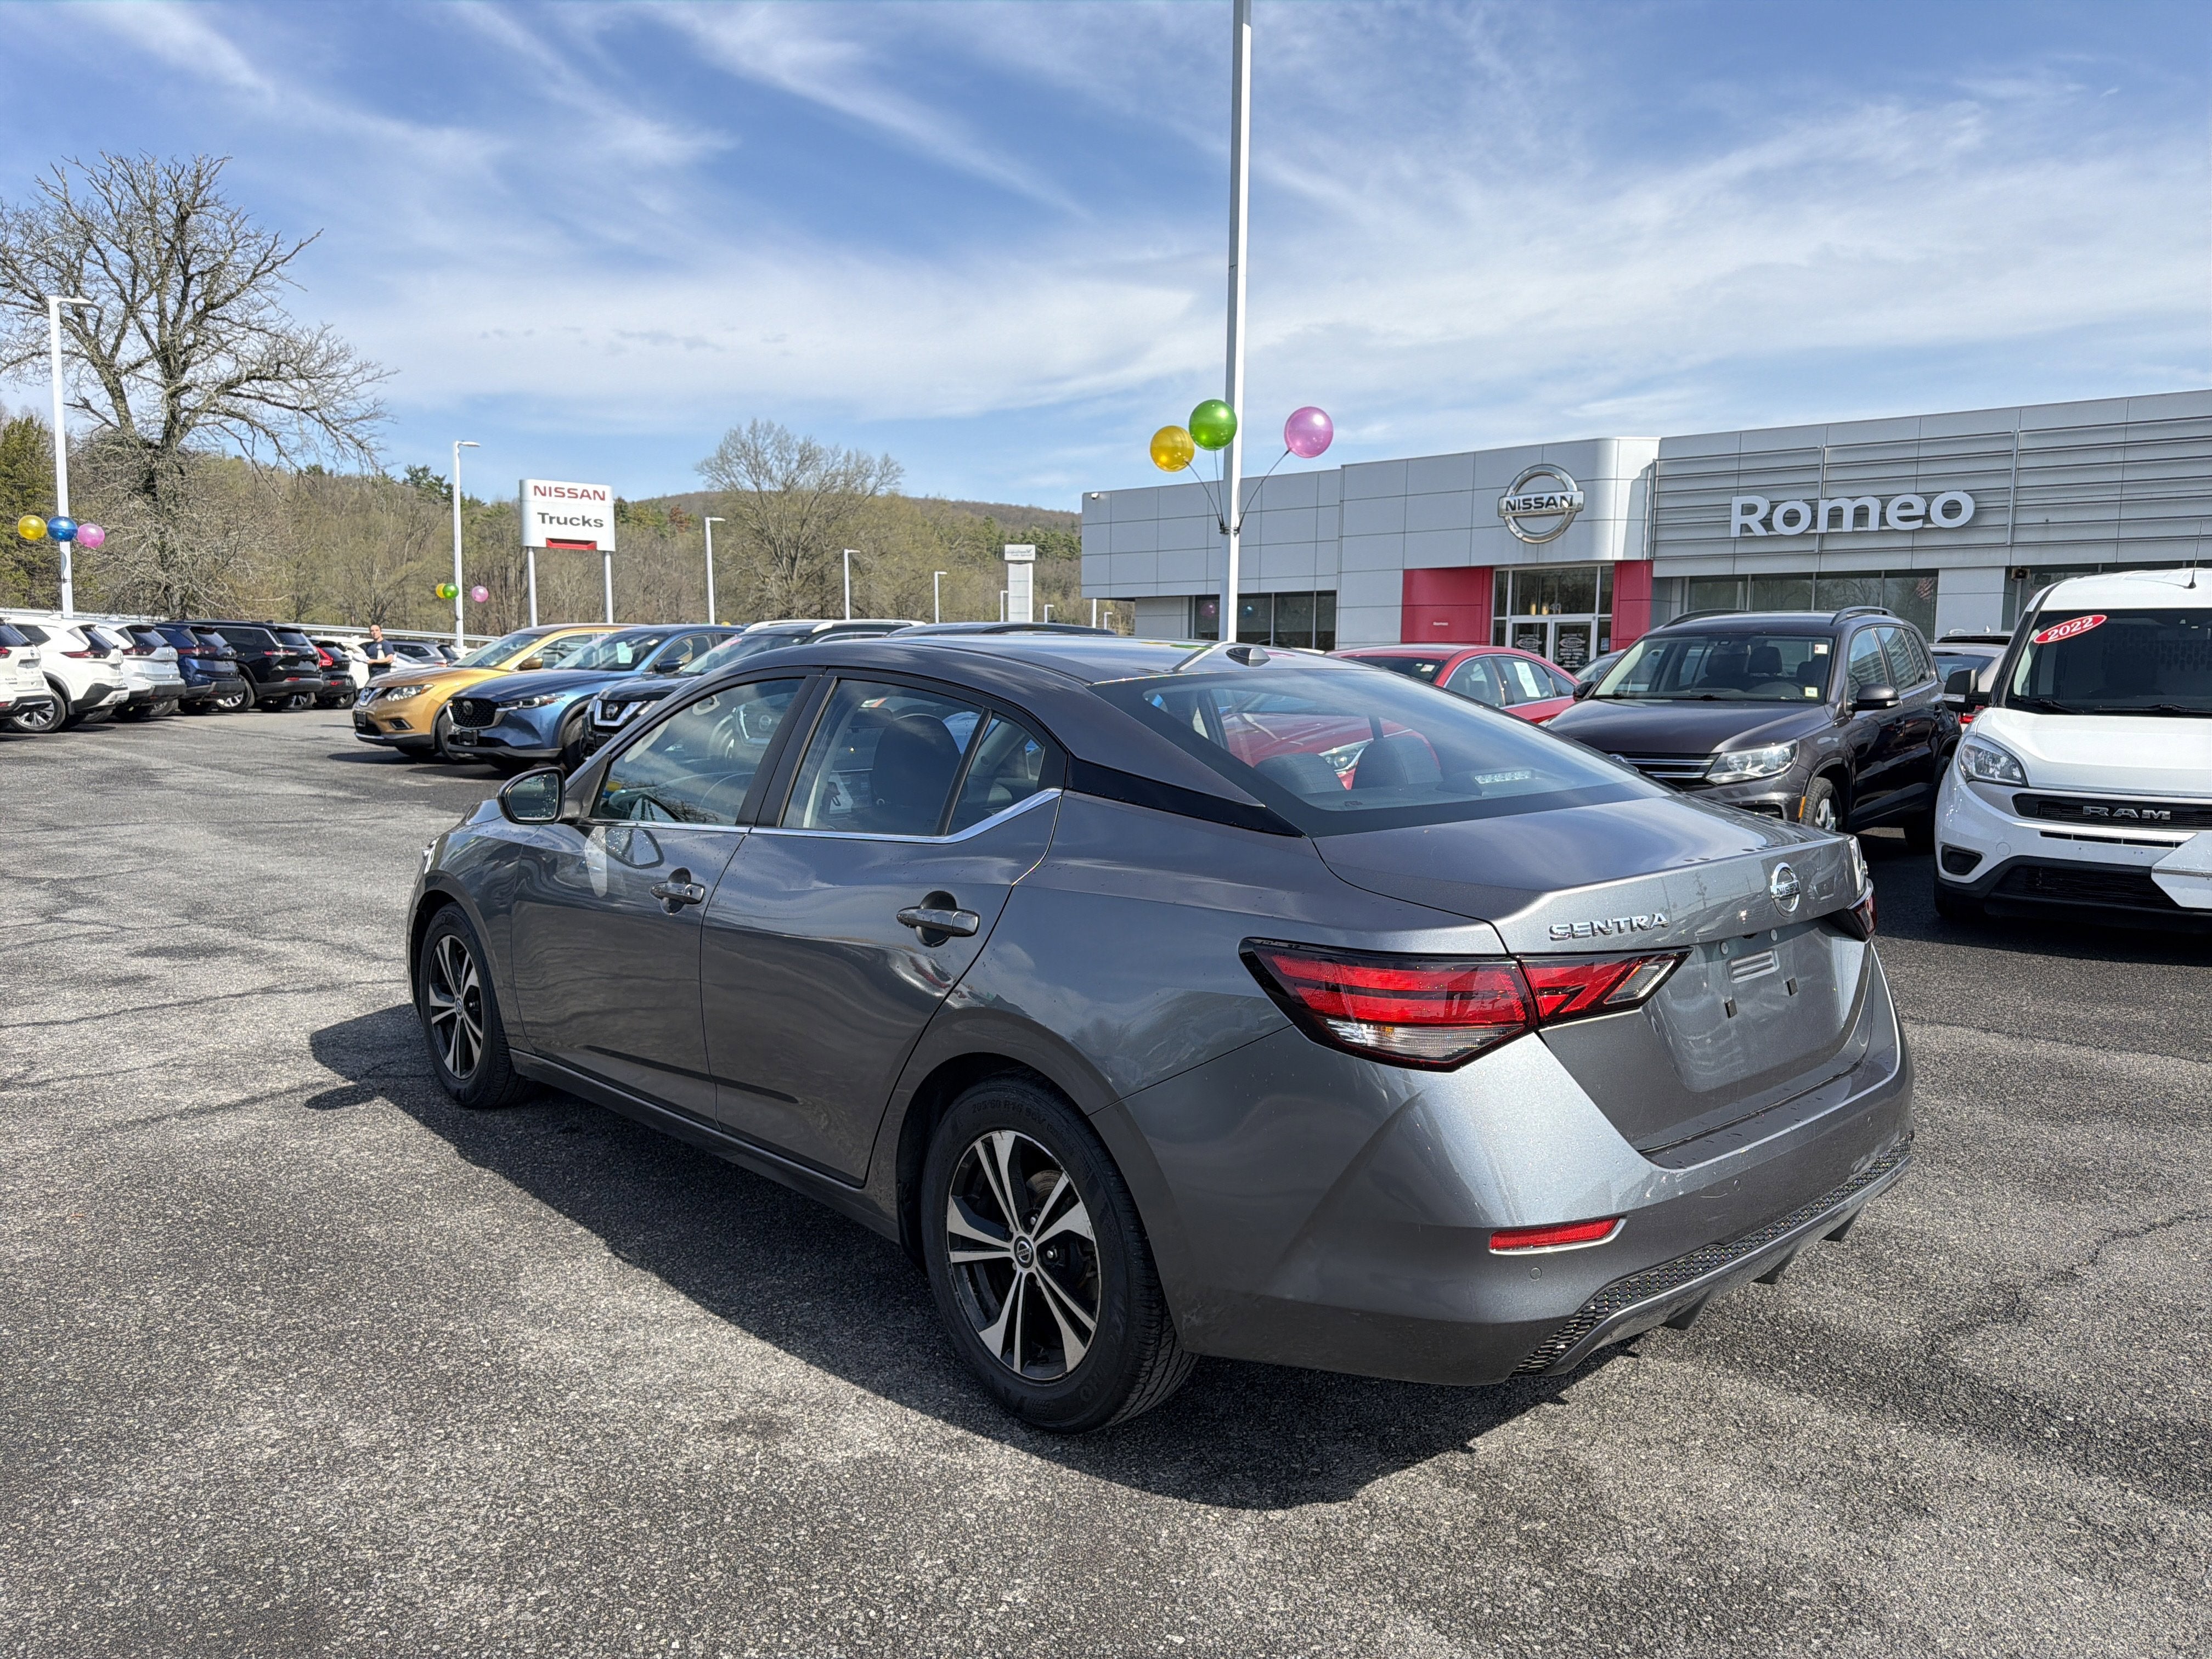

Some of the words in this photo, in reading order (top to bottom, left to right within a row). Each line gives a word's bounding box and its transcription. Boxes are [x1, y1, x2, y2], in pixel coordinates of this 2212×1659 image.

[534, 485, 606, 501] NISSAN
[1505, 495, 1573, 511] NISSAN
[537, 512, 604, 528] Trucks
[1730, 490, 1974, 537] Romeo
[2047, 617, 2094, 641] 2022
[2083, 806, 2171, 820] RAM
[1549, 913, 1669, 941] SENTRA
